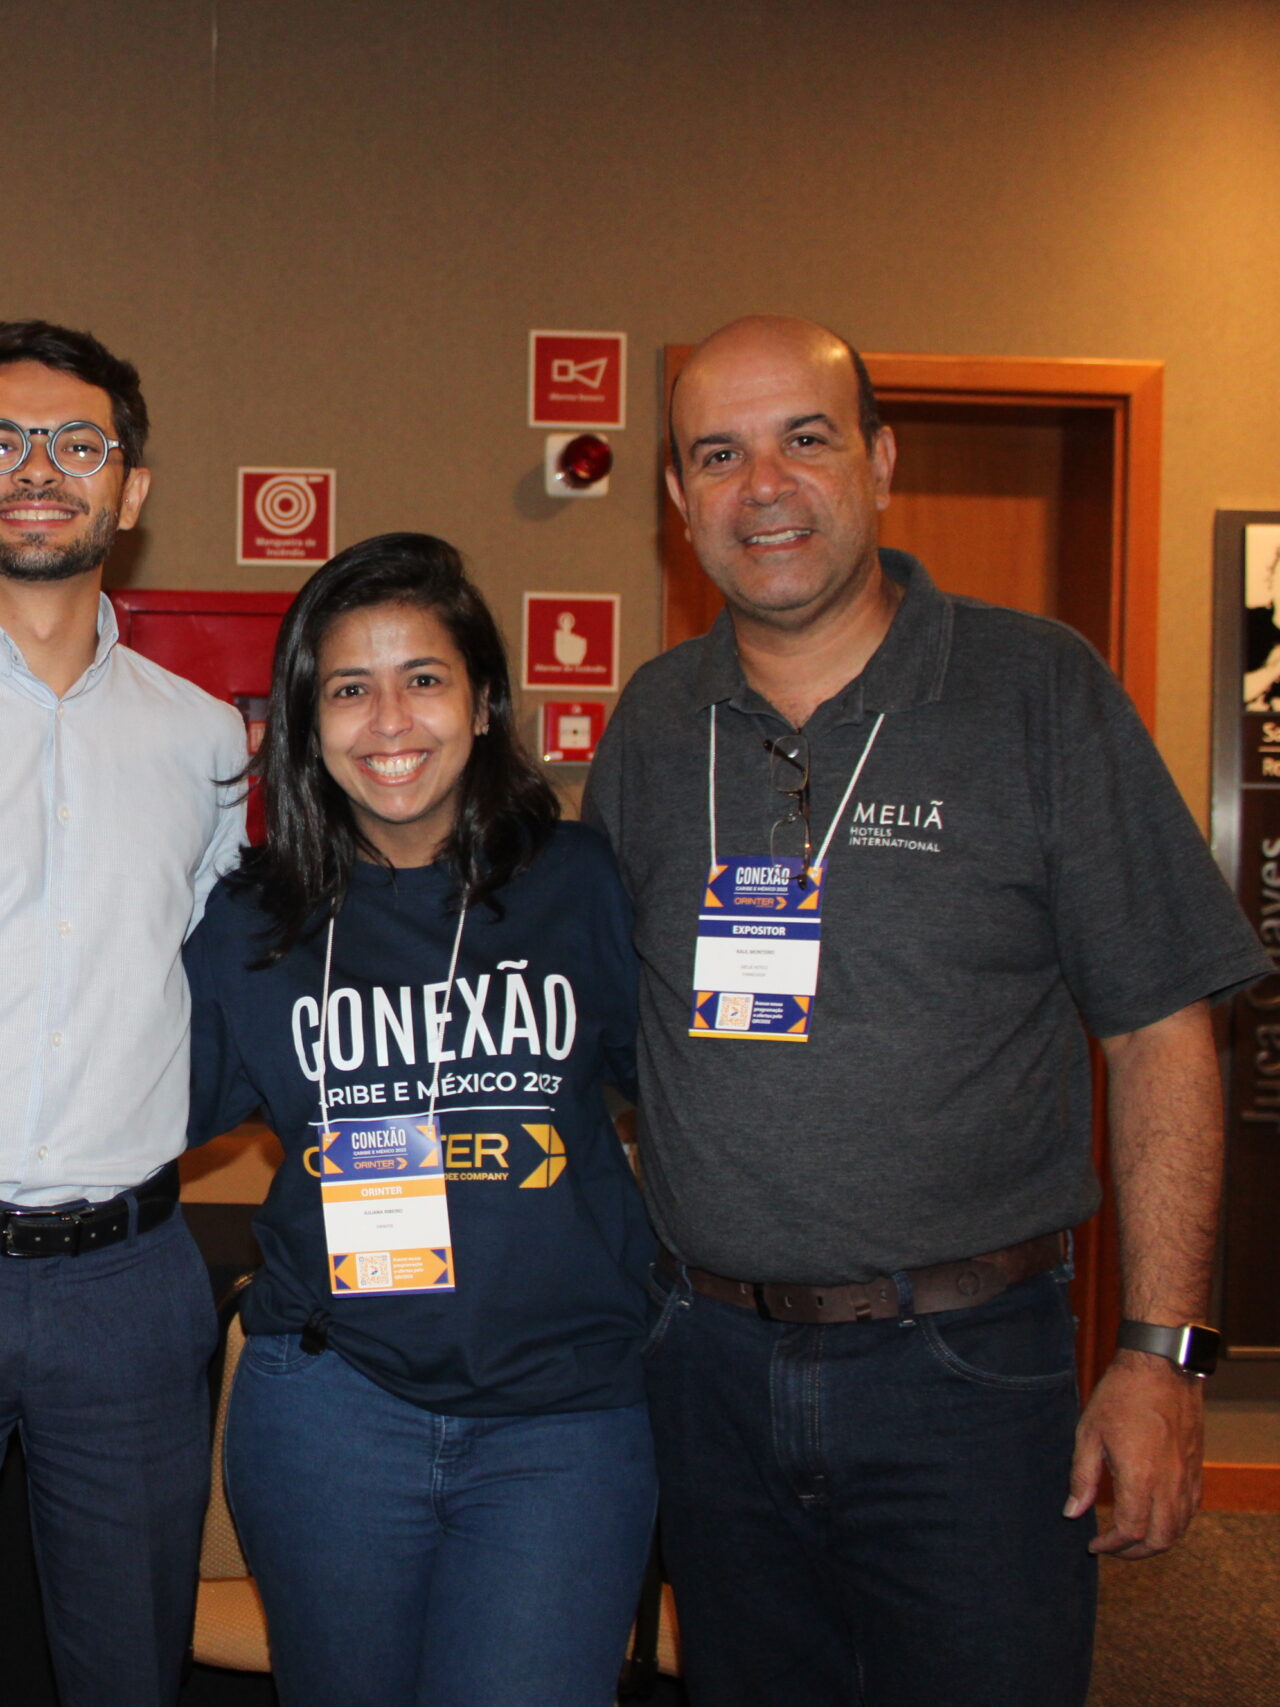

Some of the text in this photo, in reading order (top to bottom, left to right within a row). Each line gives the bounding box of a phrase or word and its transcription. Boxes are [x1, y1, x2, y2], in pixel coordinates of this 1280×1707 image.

[852, 800, 944, 830] MELIÃ
[849, 826, 893, 838] HOTELS
[848, 836, 942, 853] INTERNATIONAL
[735, 863, 791, 886] CONEXÃO
[732, 924, 787, 936] EXPOSITOR
[291, 959, 577, 1082] CONEXÃO
[394, 1081, 411, 1101] E
[416, 1071, 517, 1100] MÉXICO
[351, 1126, 407, 1150] CONEXÃO
[353, 1159, 395, 1169] ORINTER
[460, 1172, 510, 1181] COMPANY
[361, 1186, 403, 1197] ORINTER
